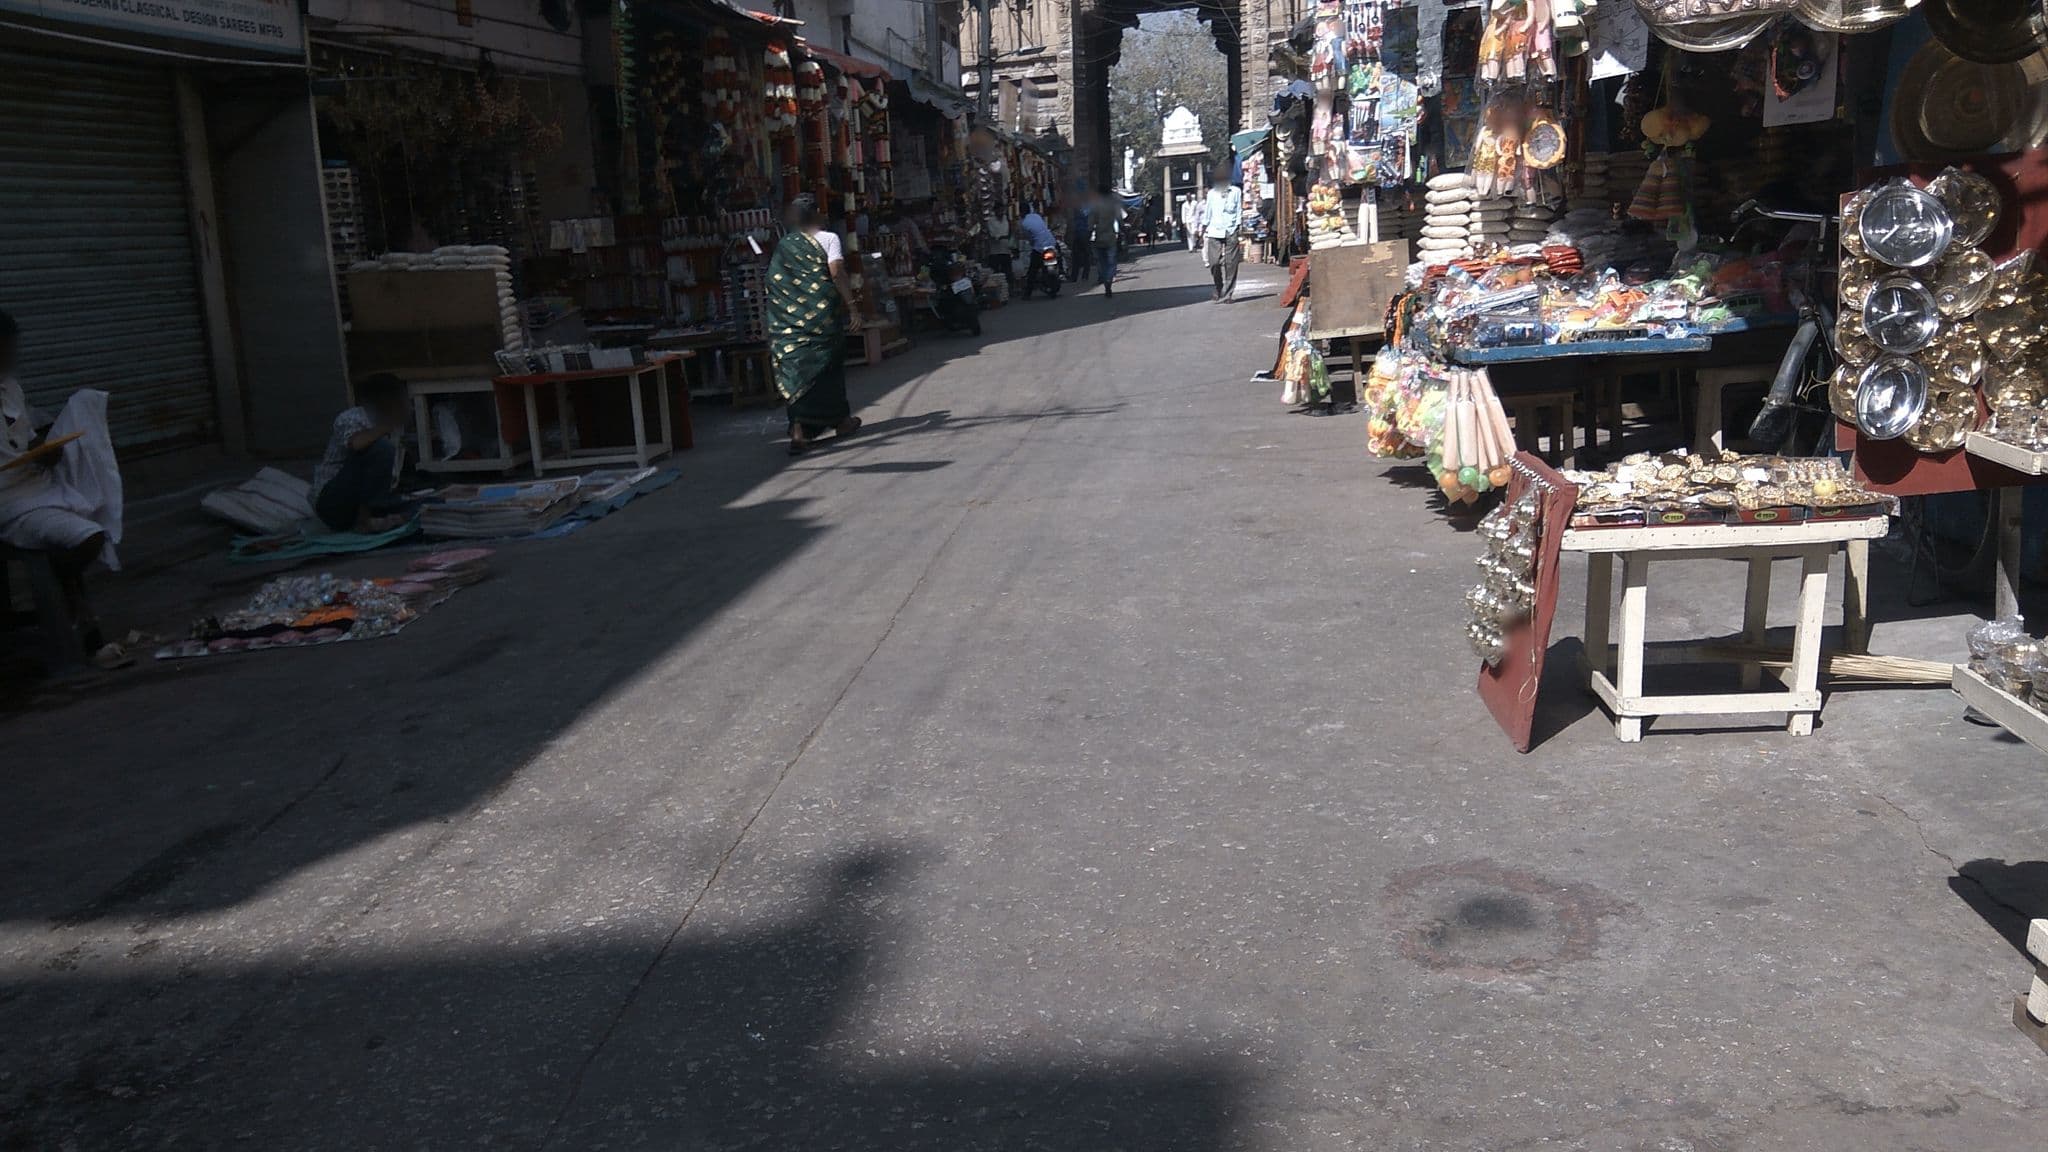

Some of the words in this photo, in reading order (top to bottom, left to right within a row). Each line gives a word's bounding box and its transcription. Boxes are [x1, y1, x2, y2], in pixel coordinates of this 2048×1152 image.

[120, 0, 180, 20] CLASSICAL
[183, 10, 218, 27] DESIGN
[219, 16, 257, 33] SAREES
[259, 23, 284, 38] MFRS
